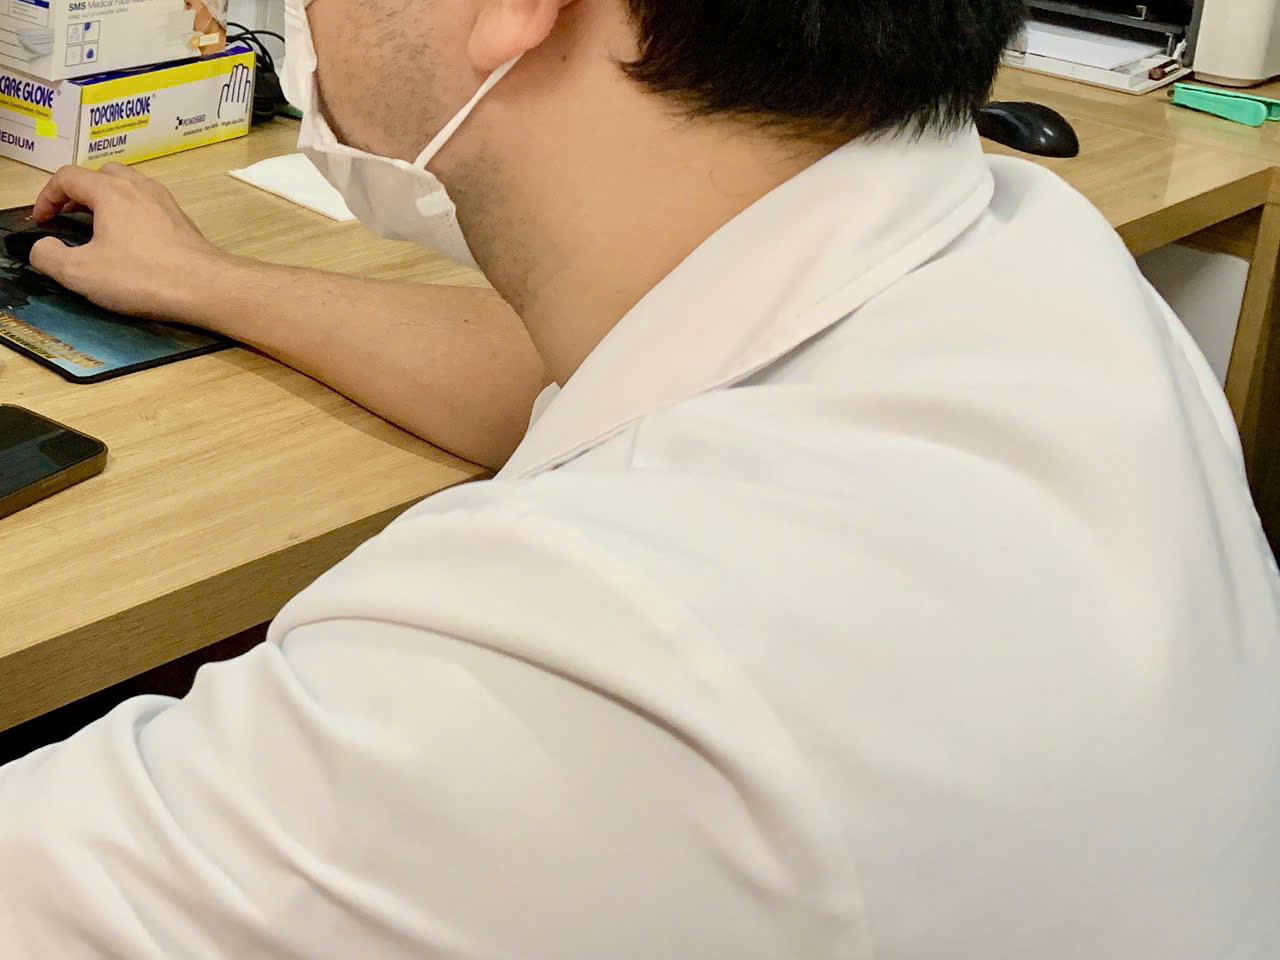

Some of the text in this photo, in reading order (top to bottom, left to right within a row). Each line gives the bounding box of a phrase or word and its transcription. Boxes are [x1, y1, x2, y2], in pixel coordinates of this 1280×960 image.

[68, 1, 86, 12] SMS
[23, 82, 54, 108] GLOVE
[90, 96, 151, 127] TOPCARE GLOVE
[88, 134, 127, 153] MEDIUM
